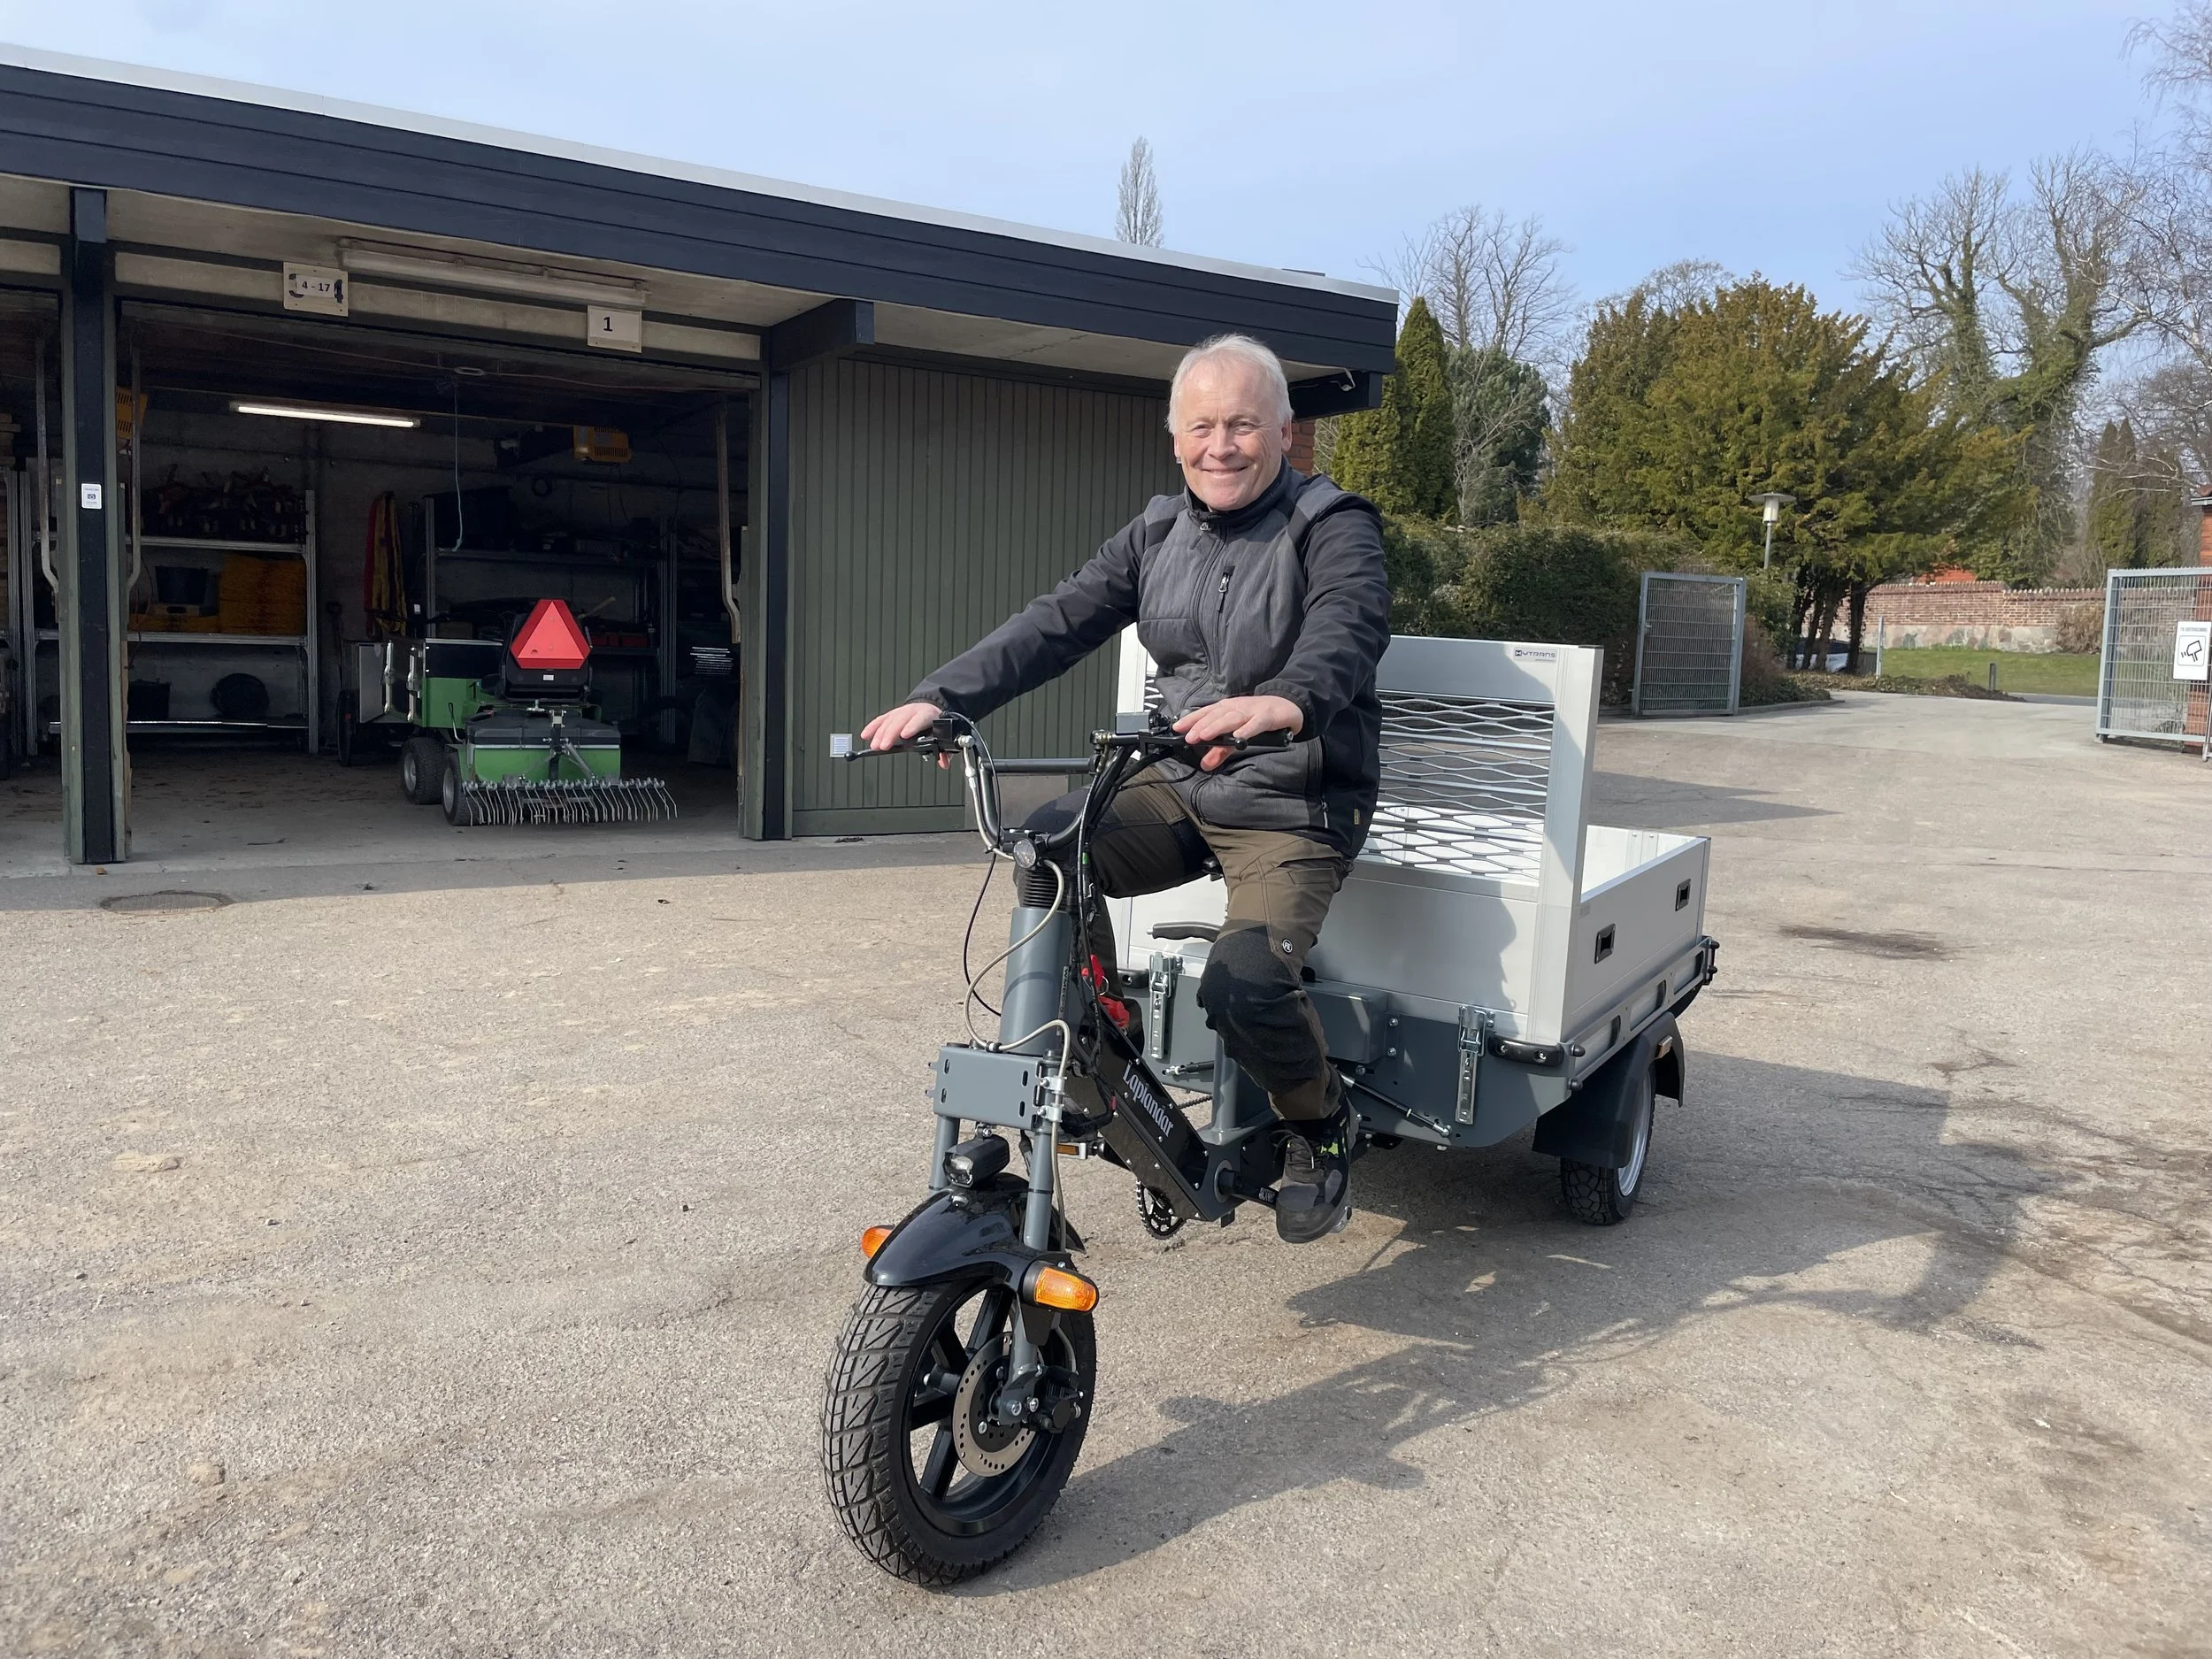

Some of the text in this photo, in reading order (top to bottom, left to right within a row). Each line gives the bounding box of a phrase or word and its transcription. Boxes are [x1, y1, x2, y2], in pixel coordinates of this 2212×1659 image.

[302, 280, 309, 289] 4
[318, 282, 331, 293] 17
[603, 316, 613, 332] 1
